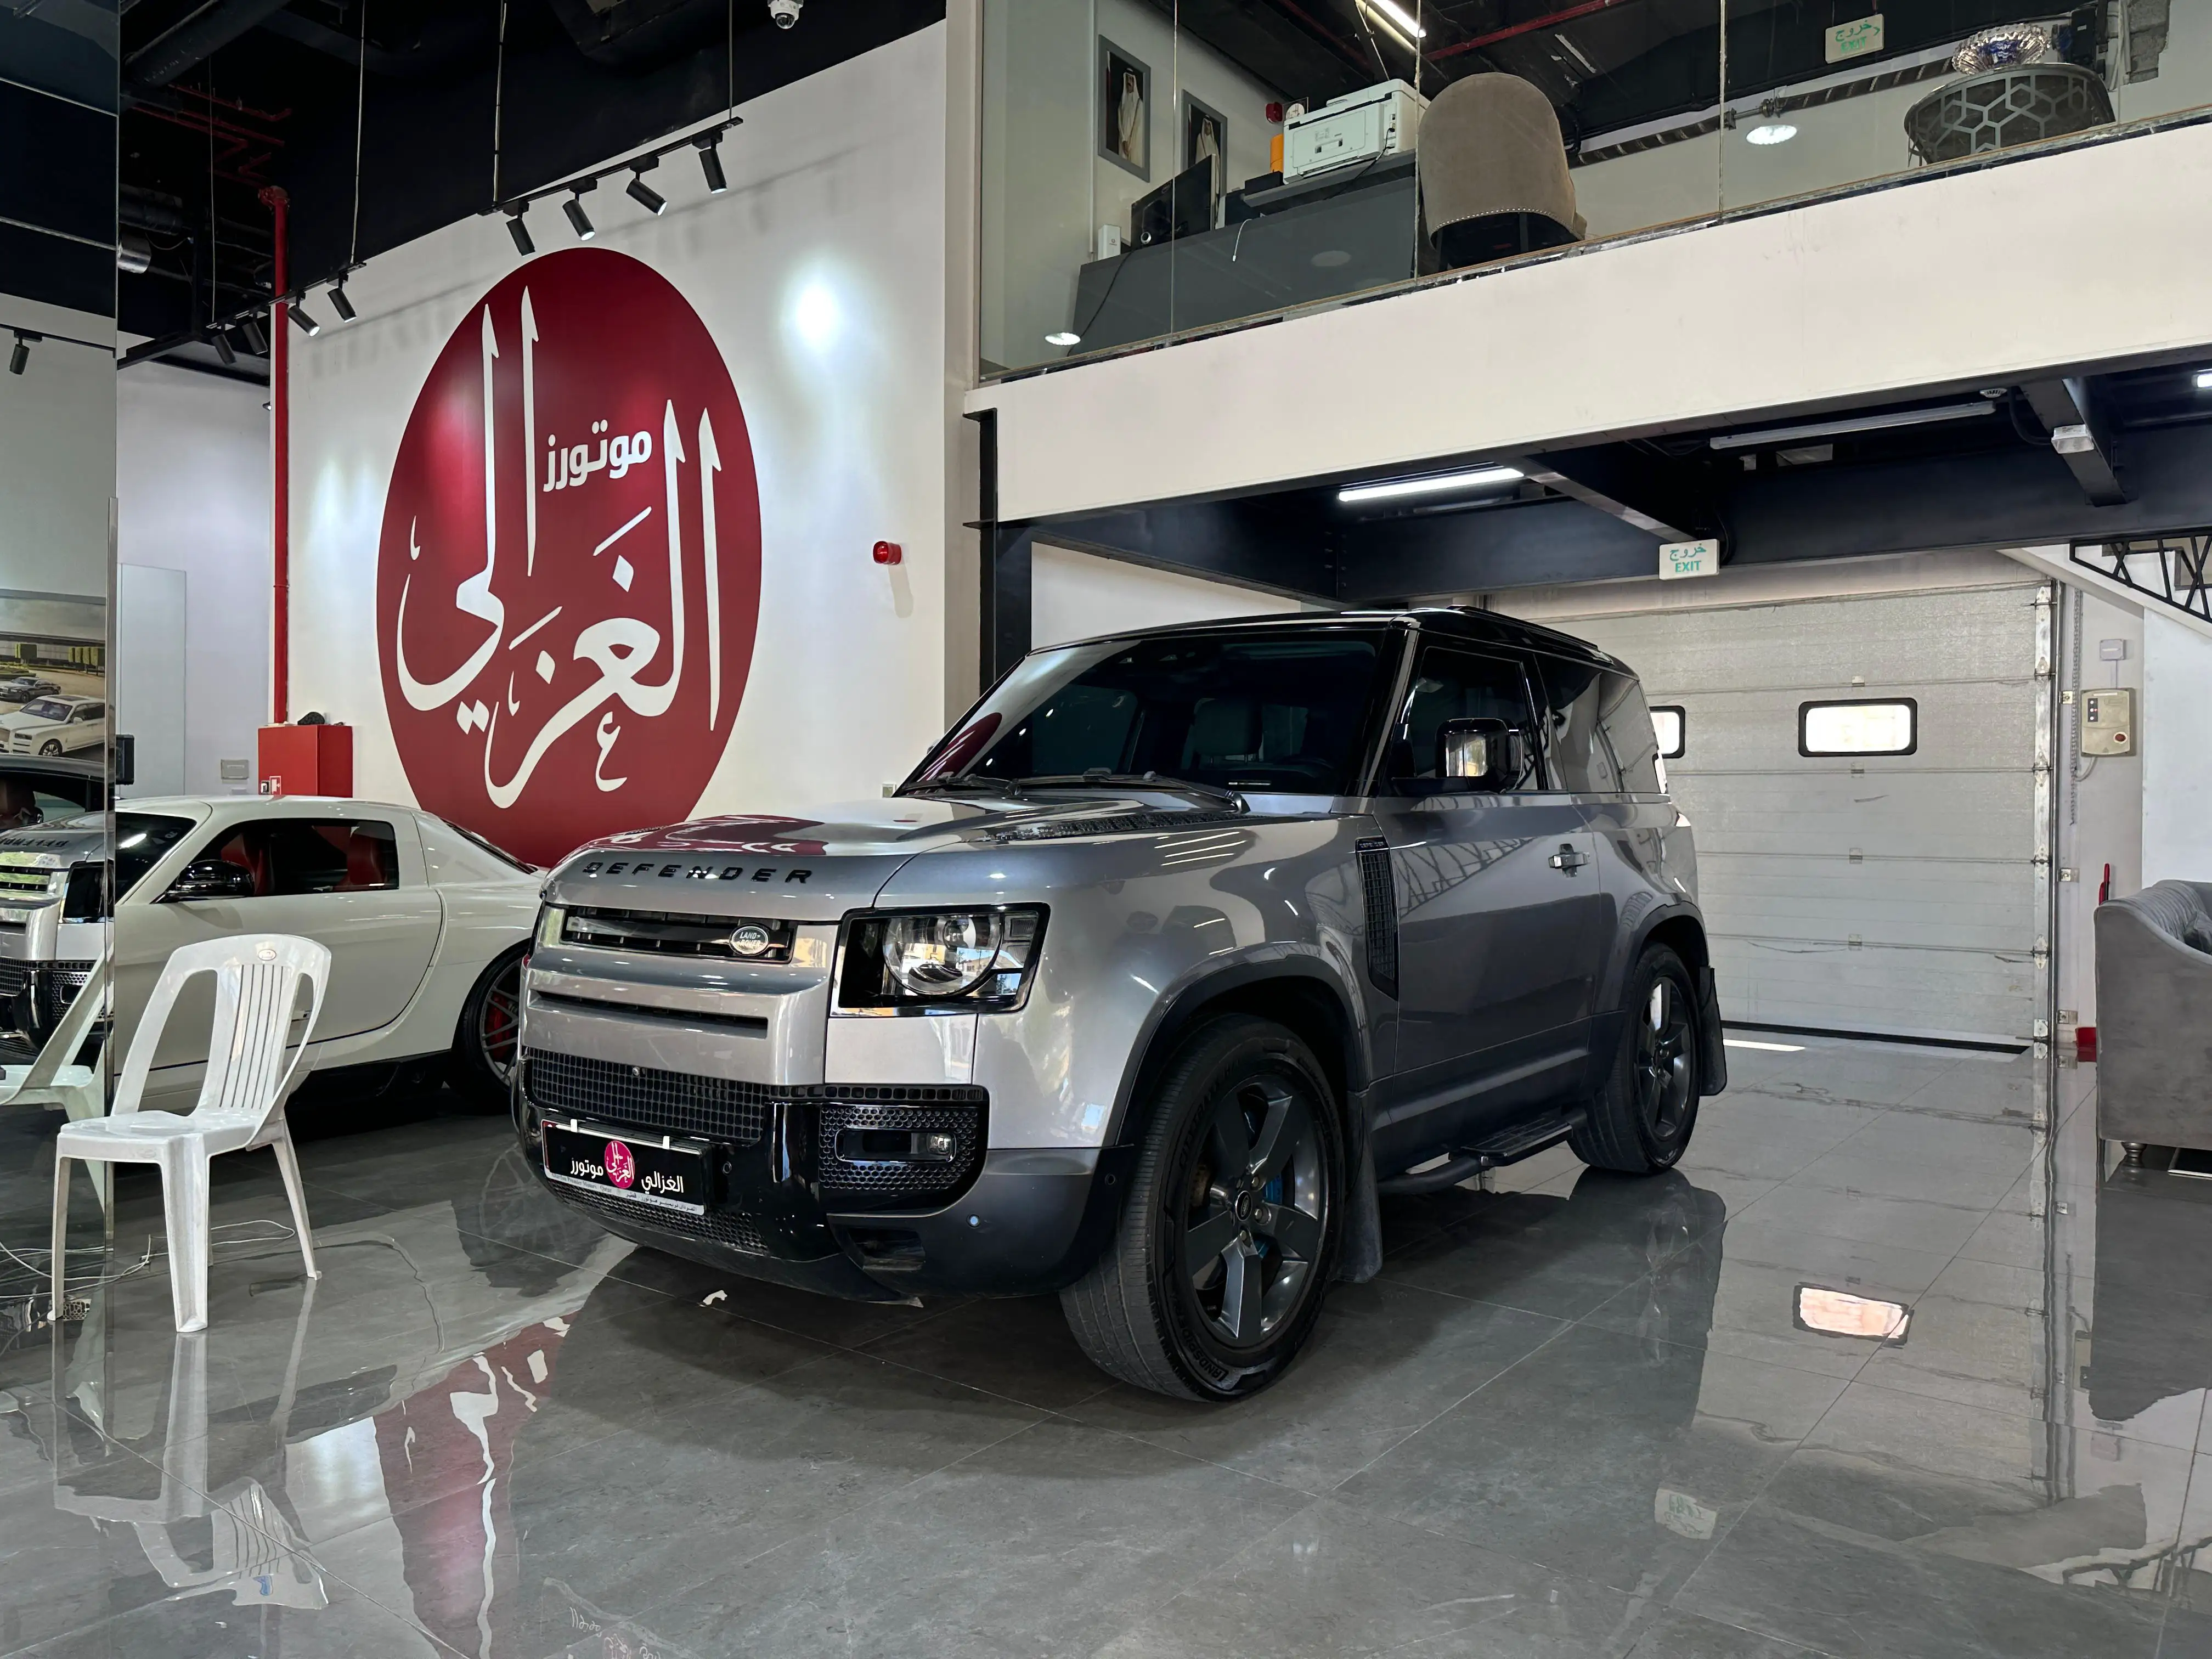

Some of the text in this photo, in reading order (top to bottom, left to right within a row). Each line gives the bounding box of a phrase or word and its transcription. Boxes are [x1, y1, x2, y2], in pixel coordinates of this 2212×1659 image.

[1835, 19, 1872, 42] خروج
[1841, 36, 1867, 53] EXIT
[543, 419, 652, 492] موتورز
[1669, 543, 1707, 561] خروج
[1675, 560, 1702, 573] EXIT
[582, 861, 812, 884] DEFENDER
[741, 939, 761, 947] ROVER
[570, 1158, 684, 1194] الغزالي موتورز
